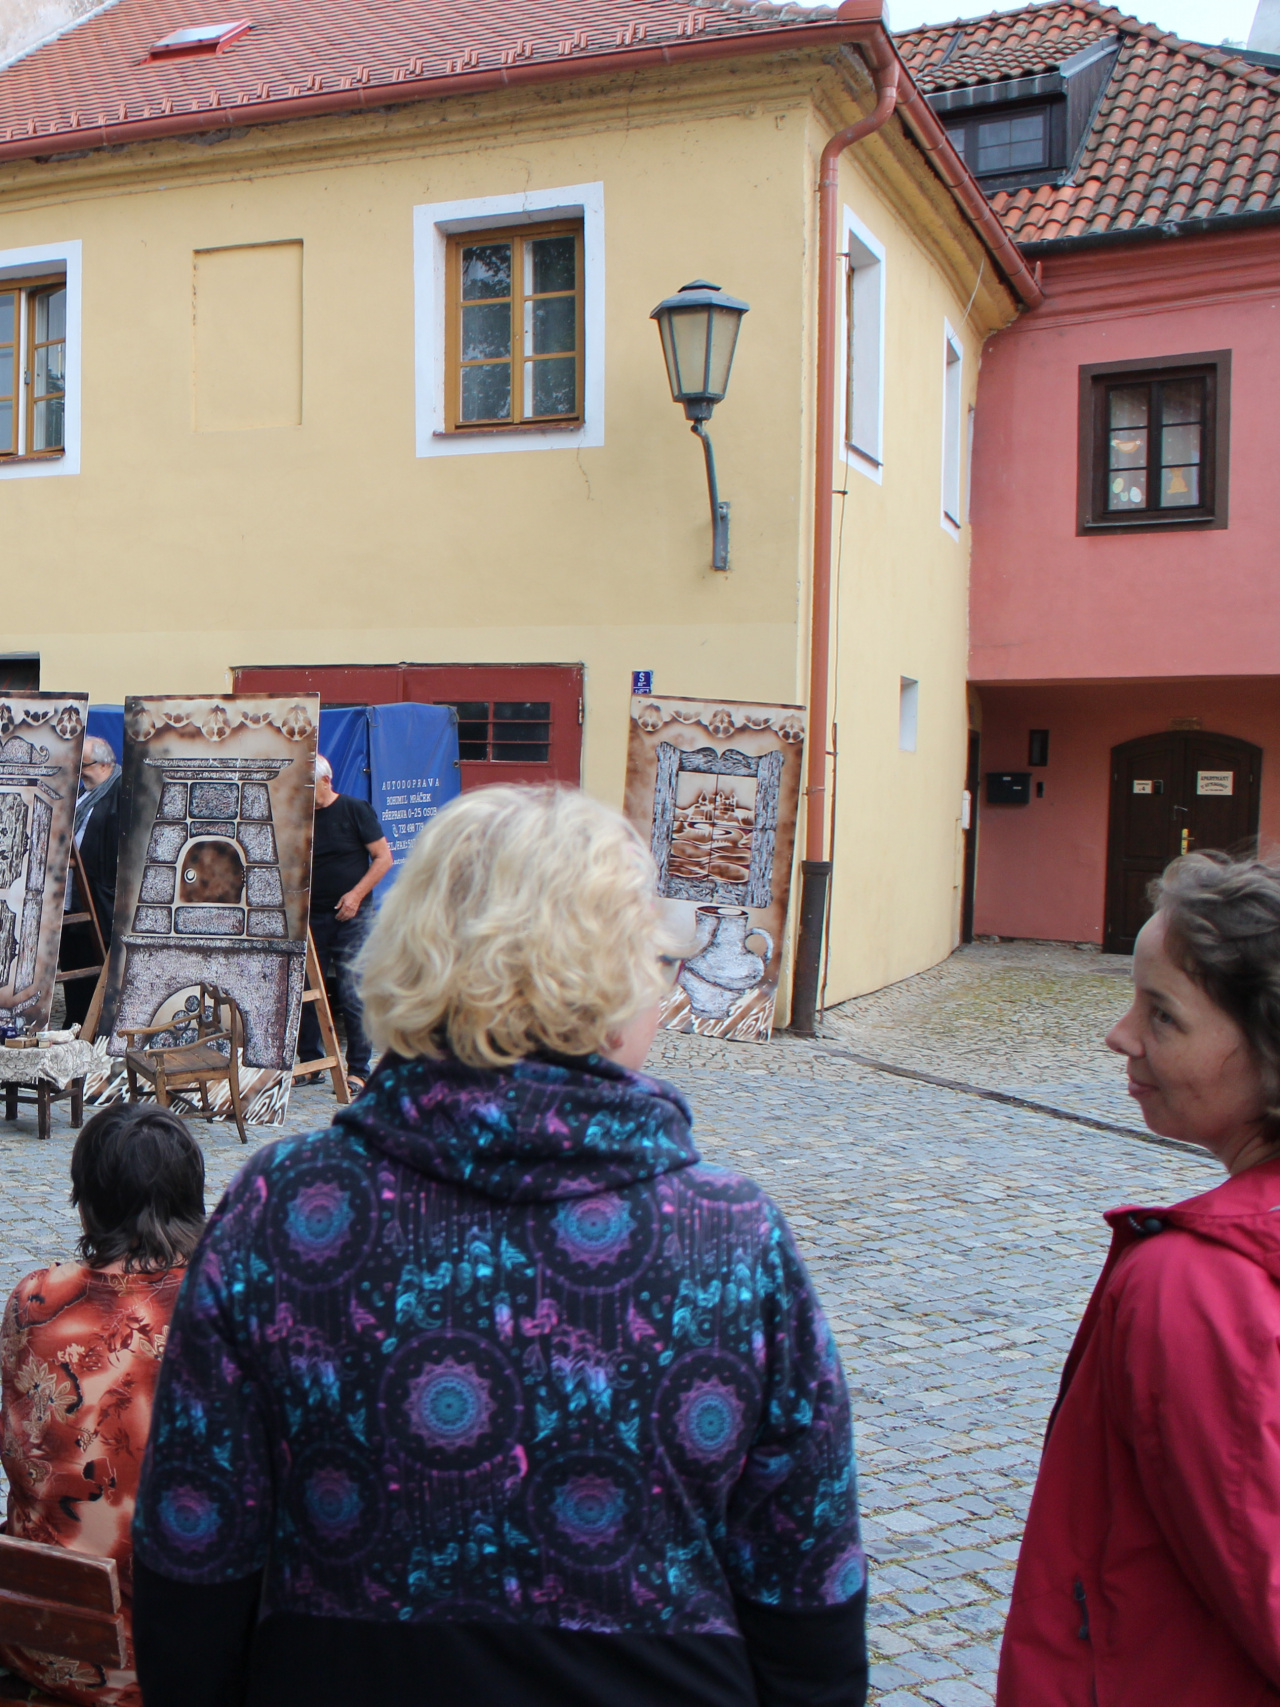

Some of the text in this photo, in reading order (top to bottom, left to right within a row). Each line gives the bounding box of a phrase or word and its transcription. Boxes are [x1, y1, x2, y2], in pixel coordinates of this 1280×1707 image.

[382, 778, 439, 790] AUTODOPRAVA
[386, 792, 431, 805] BOHUMIL MRÁČEK
[382, 809, 407, 820] PŘEPRAVA
[407, 808, 422, 818] 0-25
